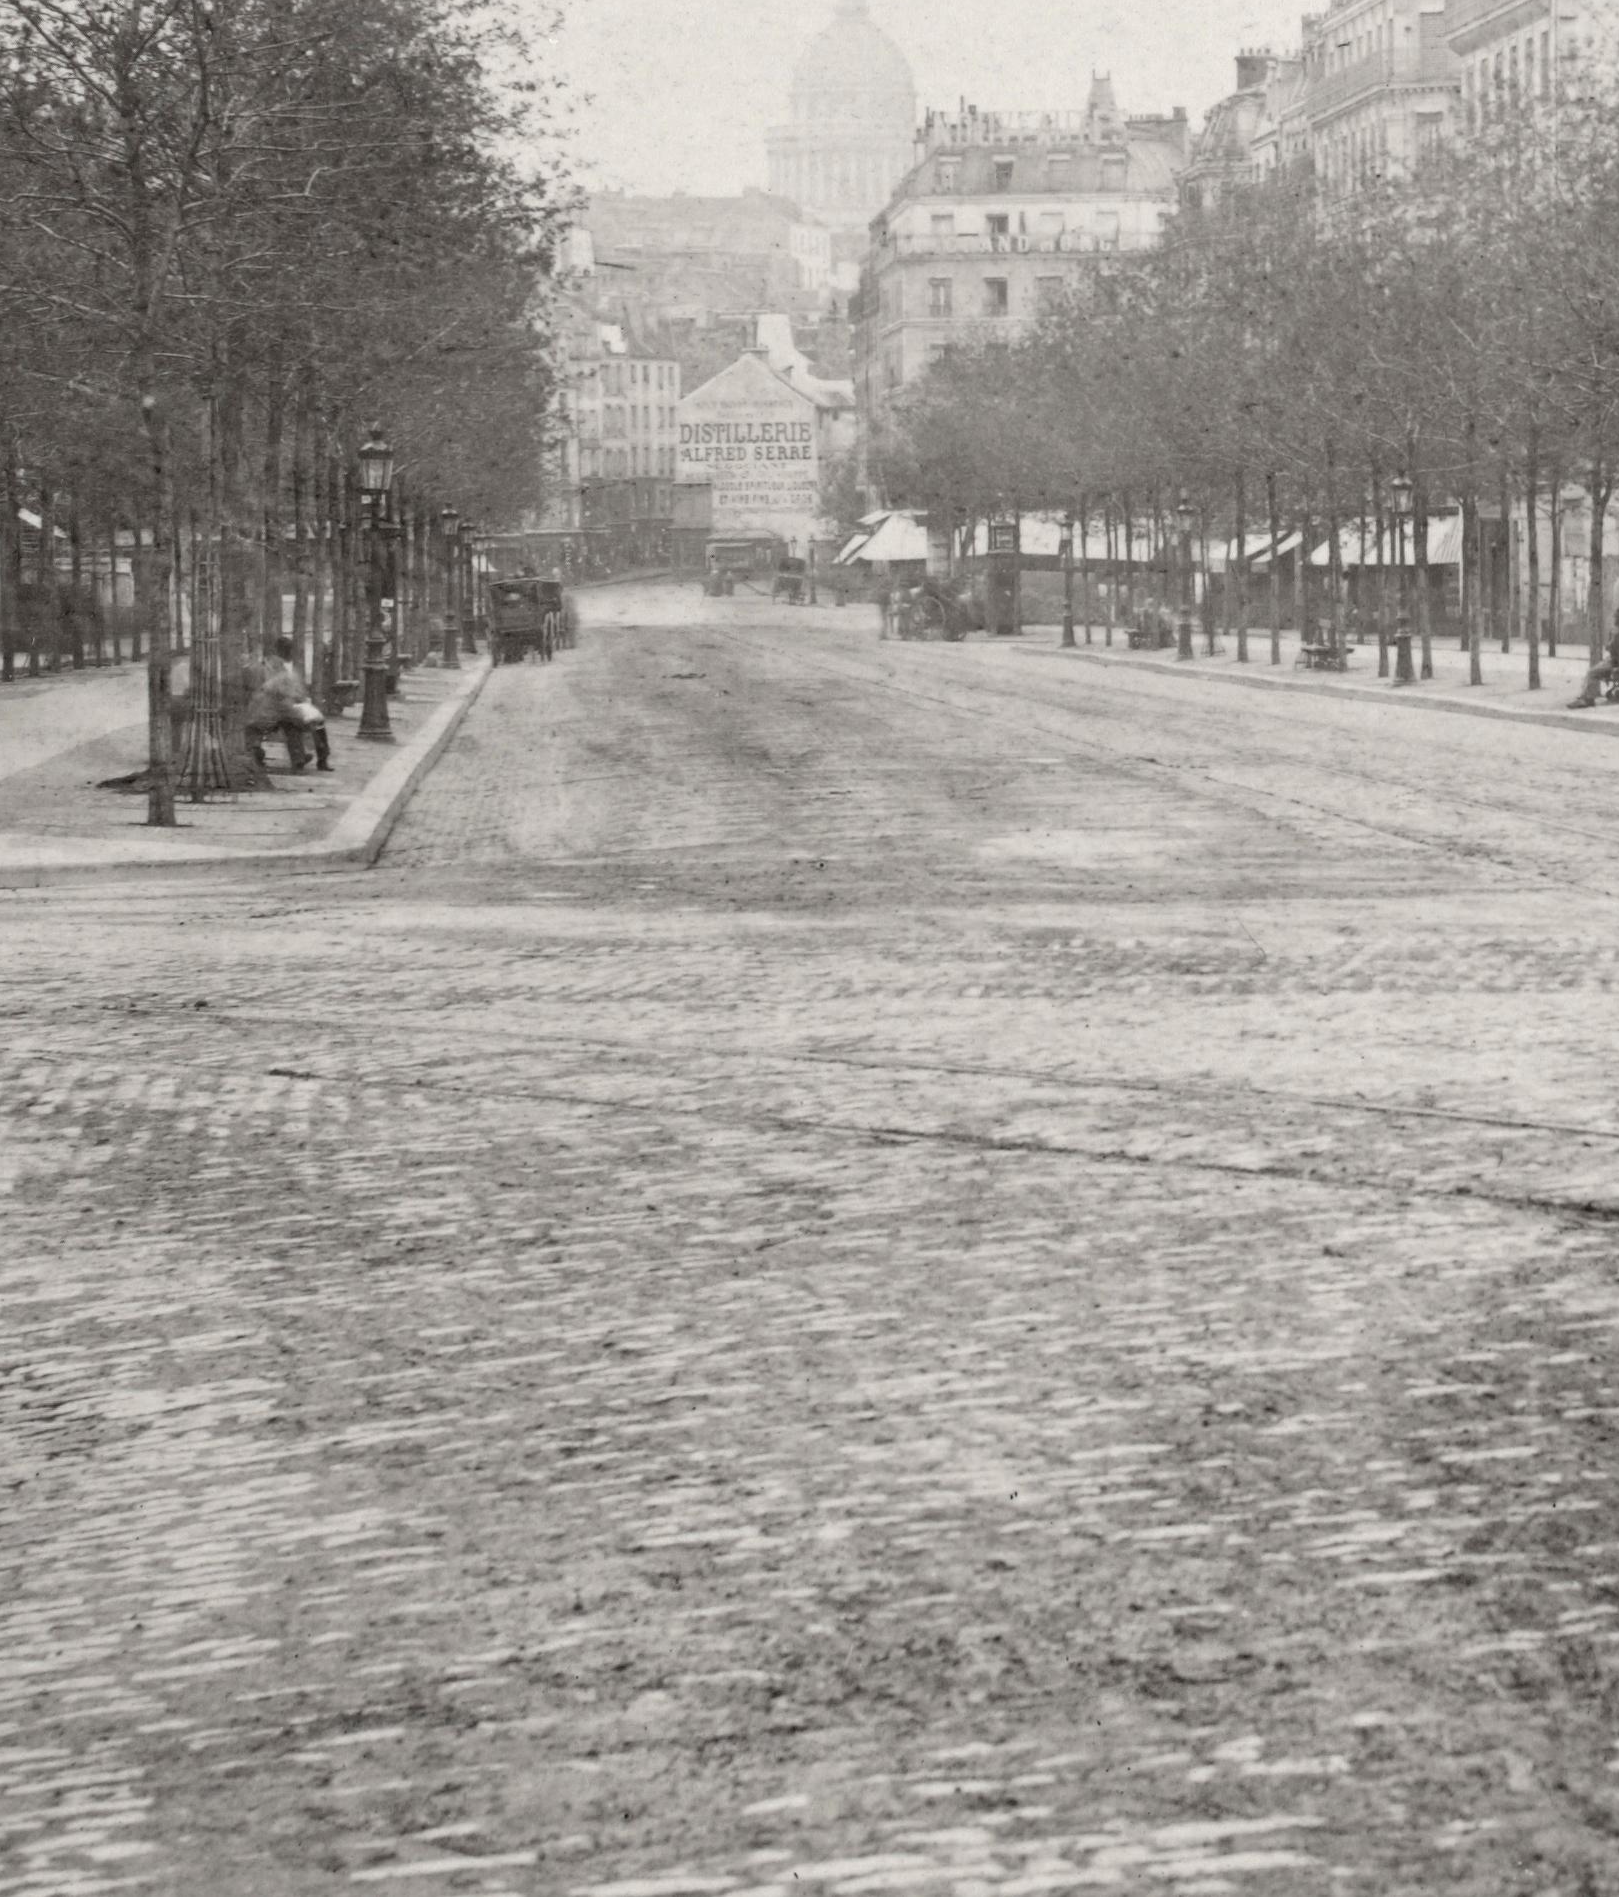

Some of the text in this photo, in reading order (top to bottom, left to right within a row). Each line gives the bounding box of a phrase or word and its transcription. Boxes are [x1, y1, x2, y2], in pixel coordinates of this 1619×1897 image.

[679, 422, 812, 444] DISTILLERIE
[680, 445, 812, 462] ALFRED SERRE
